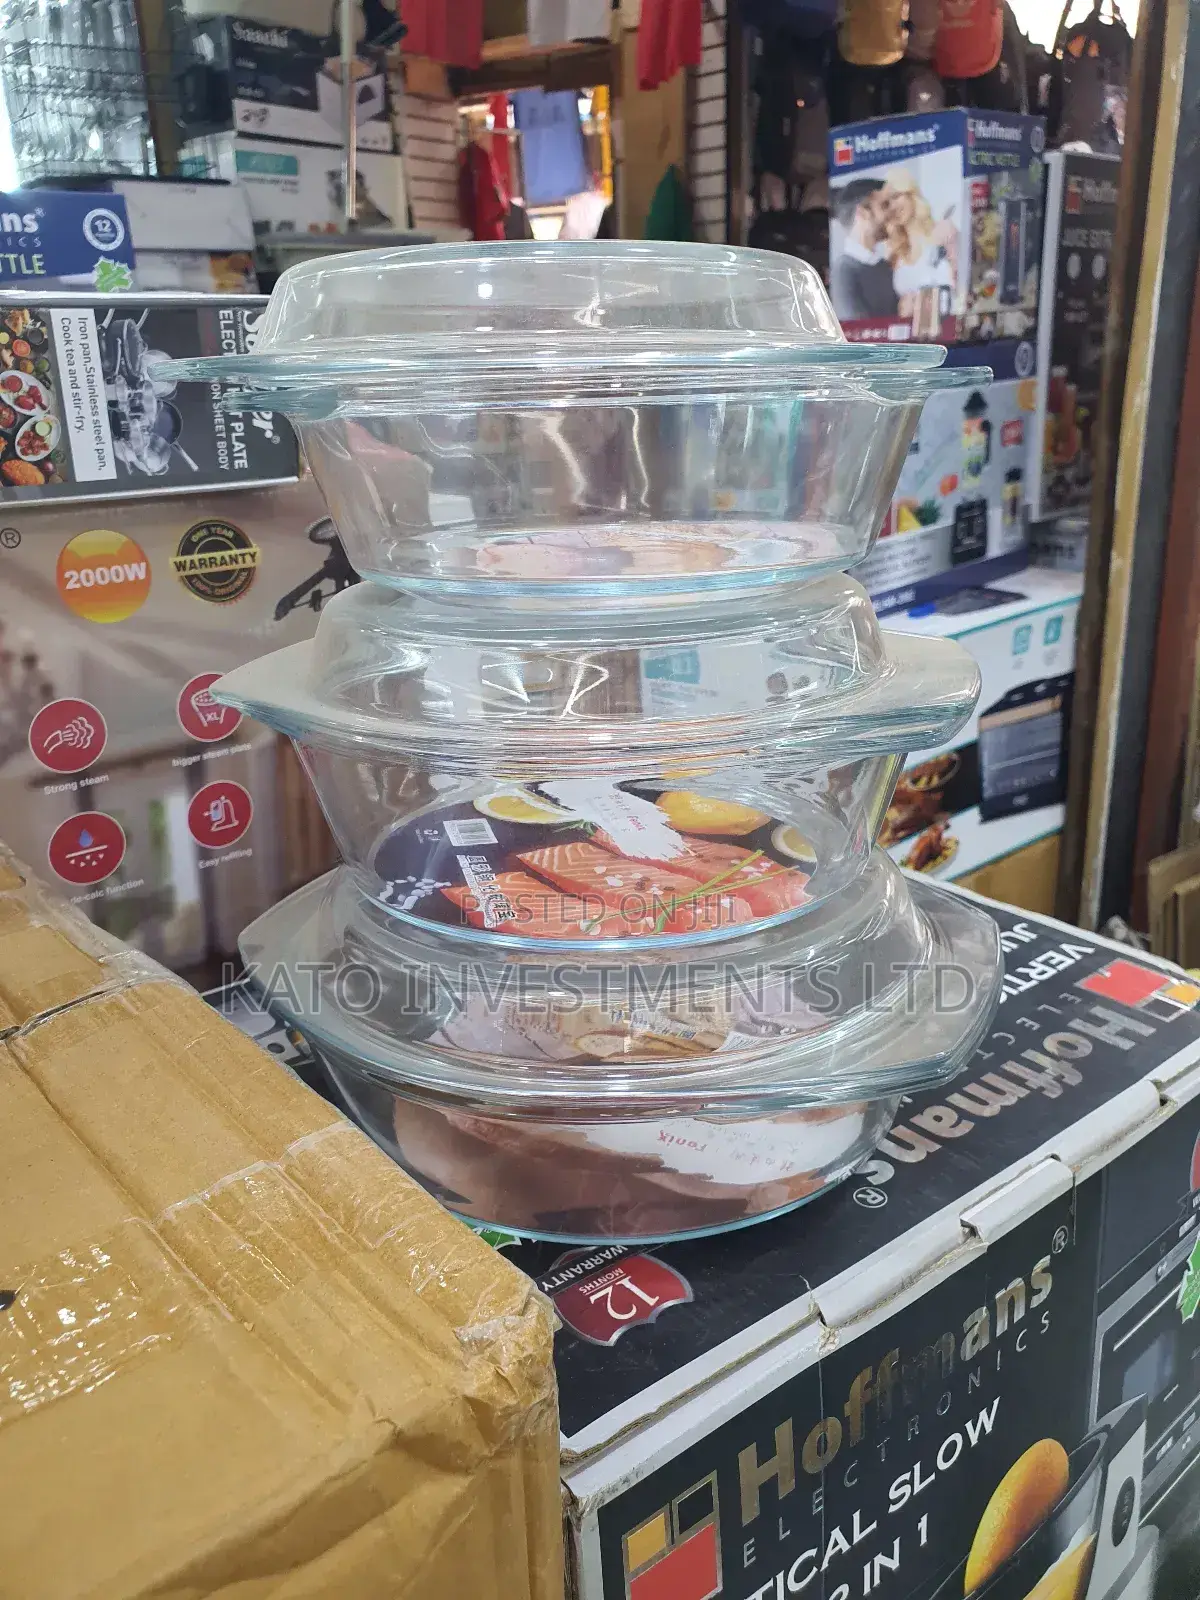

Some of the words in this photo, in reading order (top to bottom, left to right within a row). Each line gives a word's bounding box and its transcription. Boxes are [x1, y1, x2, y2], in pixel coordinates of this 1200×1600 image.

[60, 317, 72, 346] Cook
[65, 347, 76, 367] tea
[68, 368, 81, 390] and
[77, 317, 89, 339] Iron
[92, 418, 105, 446] steel
[216, 440, 230, 471] BODY
[229, 422, 248, 470] PLATE
[63, 561, 147, 590] 2000W
[173, 551, 257, 573] WARRANTY
[205, 711, 220, 722] XL
[202, 748, 230, 760] steam
[43, 780, 78, 796] Strong
[79, 773, 110, 788] steam
[198, 857, 220, 869] Easy
[105, 878, 145, 896] function
[541, 1244, 629, 1292] WARRANTY
[579, 1267, 627, 1295] MONTHS
[589, 1275, 660, 1320] 12
[743, 1310, 1051, 1569] ELECTRONICS
[888, 1395, 1001, 1514] SLOW
[863, 1536, 901, 1597] IN
[917, 1512, 929, 1548] 1
